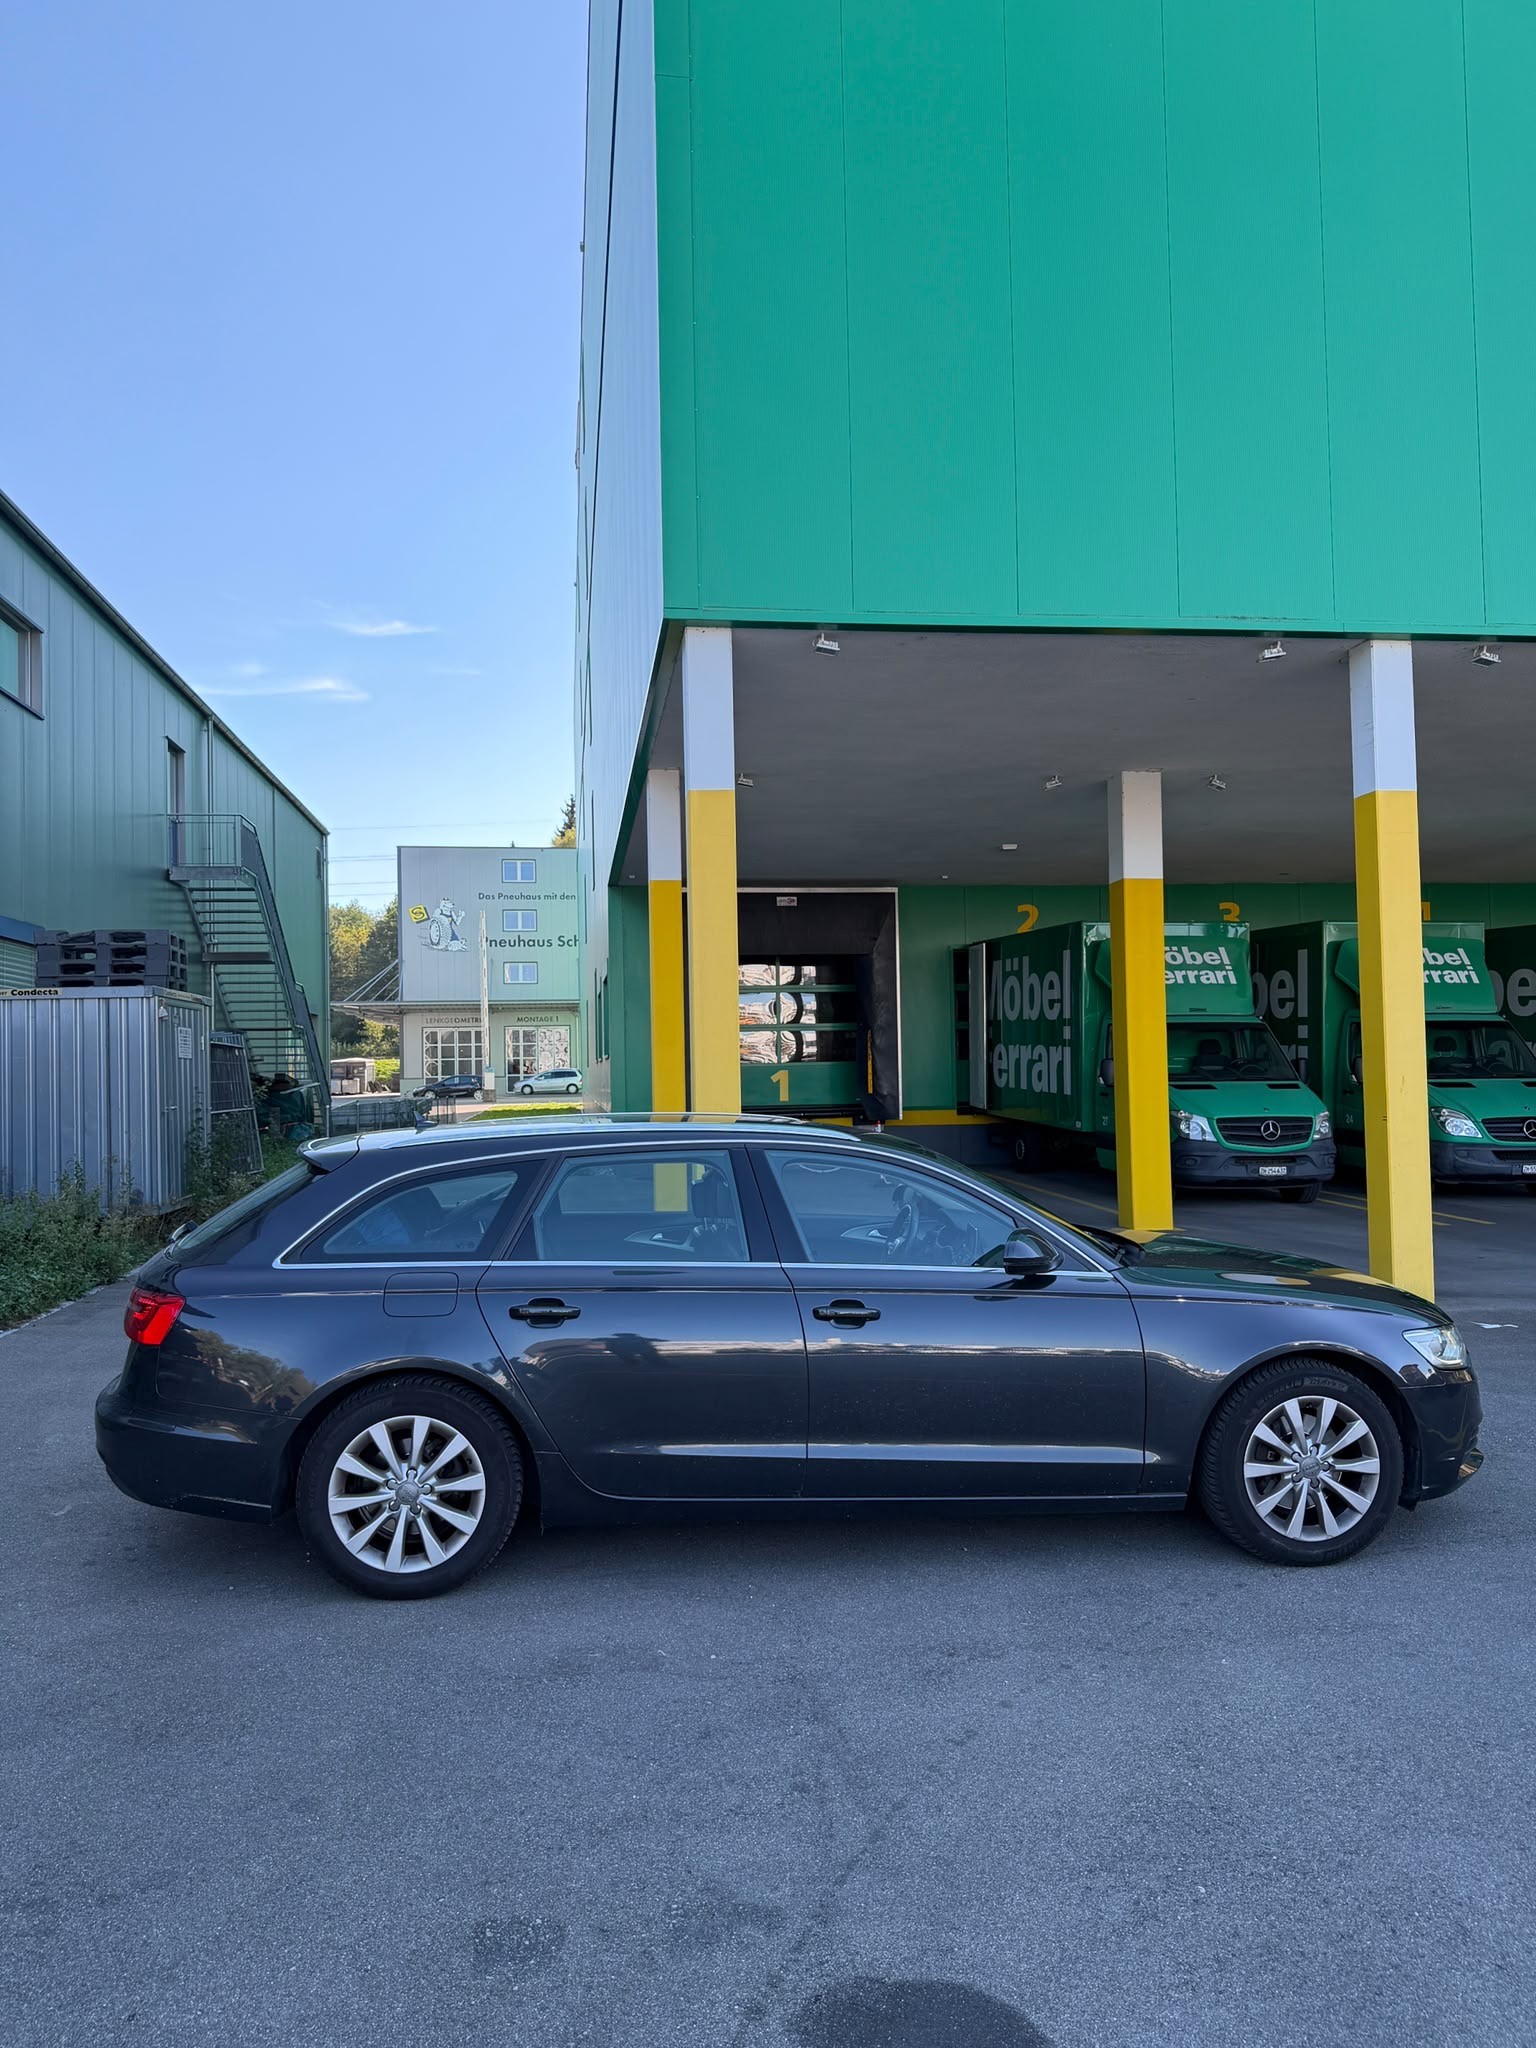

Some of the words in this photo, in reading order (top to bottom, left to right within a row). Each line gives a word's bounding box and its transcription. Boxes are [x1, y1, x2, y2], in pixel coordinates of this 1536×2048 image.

[478, 892, 495, 900] Das
[498, 892, 541, 900] Pneuhaus
[544, 892, 557, 900] mit
[560, 892, 576, 900] den
[1016, 904, 1039, 933] 2
[1164, 946, 1231, 966] öbel
[1422, 947, 1472, 966] bel
[1164, 966, 1237, 985] errari
[1423, 965, 1480, 984] rrari
[989, 1025, 1072, 1096] errari
[770, 1069, 789, 1102] 1
